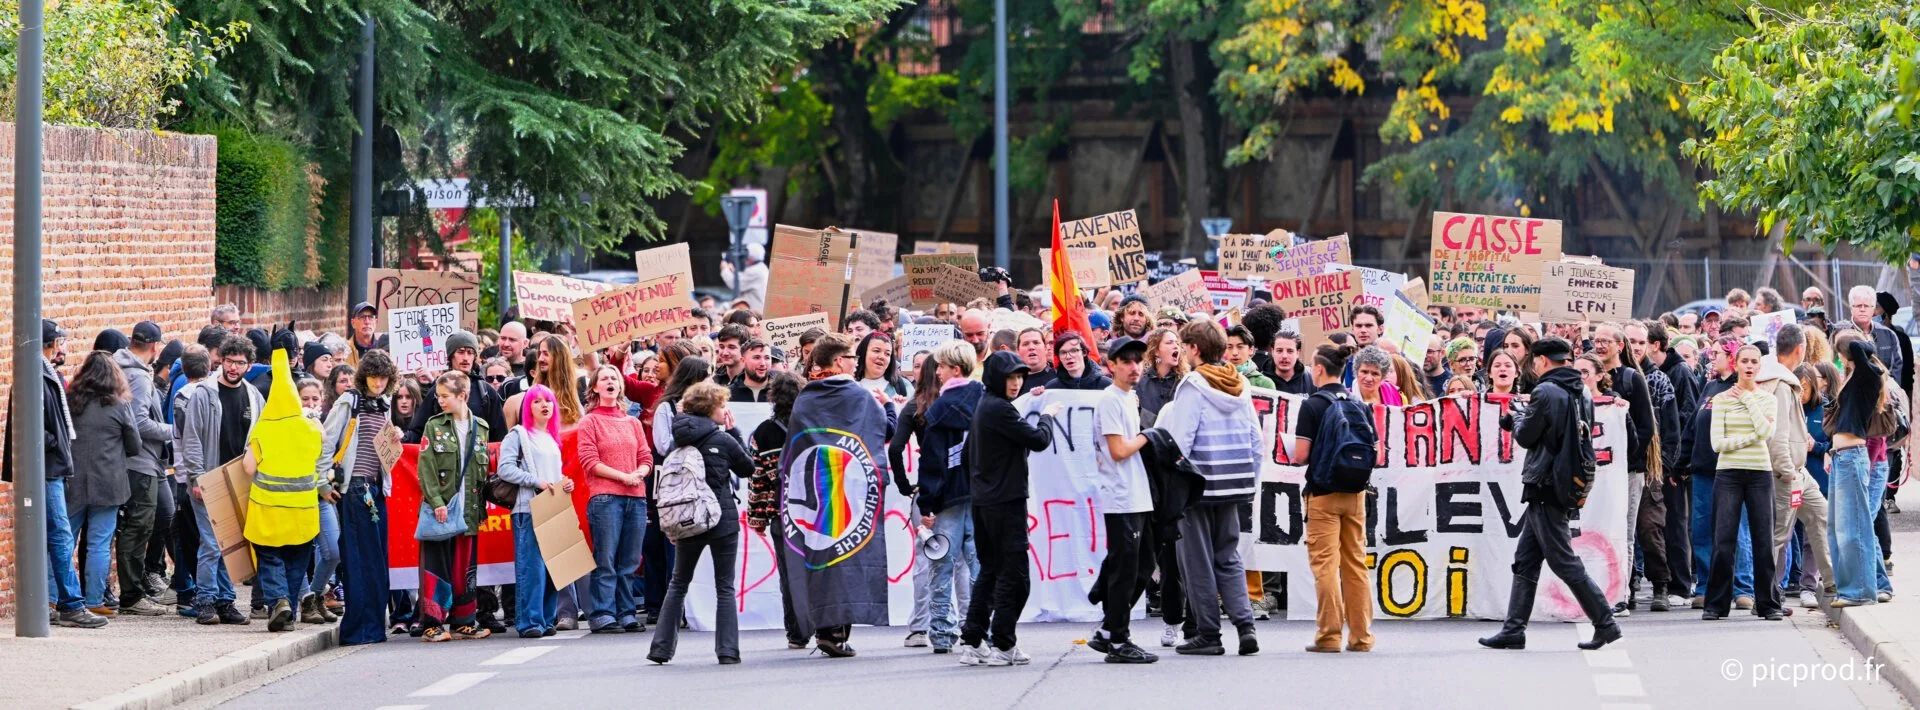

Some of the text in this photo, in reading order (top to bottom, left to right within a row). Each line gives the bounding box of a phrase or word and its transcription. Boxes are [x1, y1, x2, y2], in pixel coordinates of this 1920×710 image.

[426, 188, 462, 200] aison
[1112, 233, 1140, 250] NOS
[1442, 215, 1544, 255] CASSE
[821, 232, 832, 267] FRAGILE
[1224, 250, 1238, 259] QUI
[1287, 243, 1316, 258] VIVE
[1327, 241, 1341, 252] LA
[1434, 249, 1449, 260] DE
[1108, 250, 1147, 280] ANTS
[1239, 262, 1252, 271] LES
[1278, 252, 1338, 272] JEUNESSE
[1434, 260, 1447, 270] DE
[1434, 272, 1452, 281] DES
[1552, 266, 1616, 280] LA JEUNESSE
[562, 279, 592, 294] 404
[1273, 272, 1352, 301] ON EN PARLE
[1433, 282, 1444, 291] DE
[1447, 282, 1458, 292] LA
[1490, 285, 1500, 294] DE
[1568, 278, 1619, 289] EMMERDE
[1302, 296, 1316, 308] DE
[1320, 292, 1344, 306] CES
[1432, 294, 1443, 302] DE
[1564, 290, 1612, 300] TOUJOURS
[619, 303, 637, 316] EN
[1568, 300, 1583, 313] LE
[1587, 300, 1606, 313] FN
[432, 307, 454, 324] PAS
[766, 318, 824, 331] Gouvernement
[771, 332, 786, 340] plus
[836, 436, 879, 556] ANTIFASCHISTISCHE
[784, 474, 798, 539] AKTION
